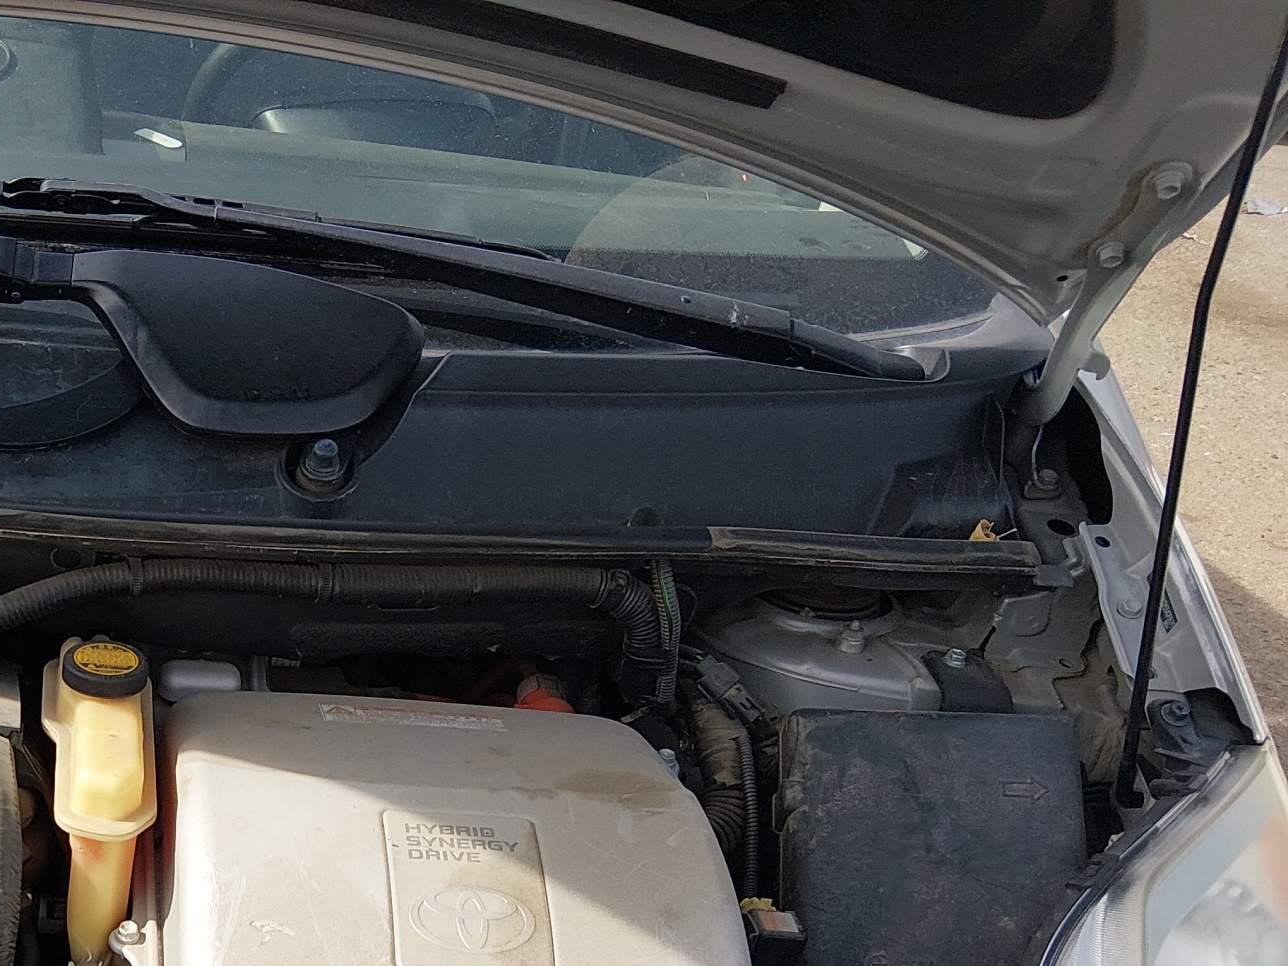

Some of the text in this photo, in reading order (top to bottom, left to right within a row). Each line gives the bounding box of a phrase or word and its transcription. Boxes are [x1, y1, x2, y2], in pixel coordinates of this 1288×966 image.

[405, 823, 496, 838] HYBRID
[406, 836, 519, 852] SYNERGY
[408, 849, 481, 863] DRIVE
